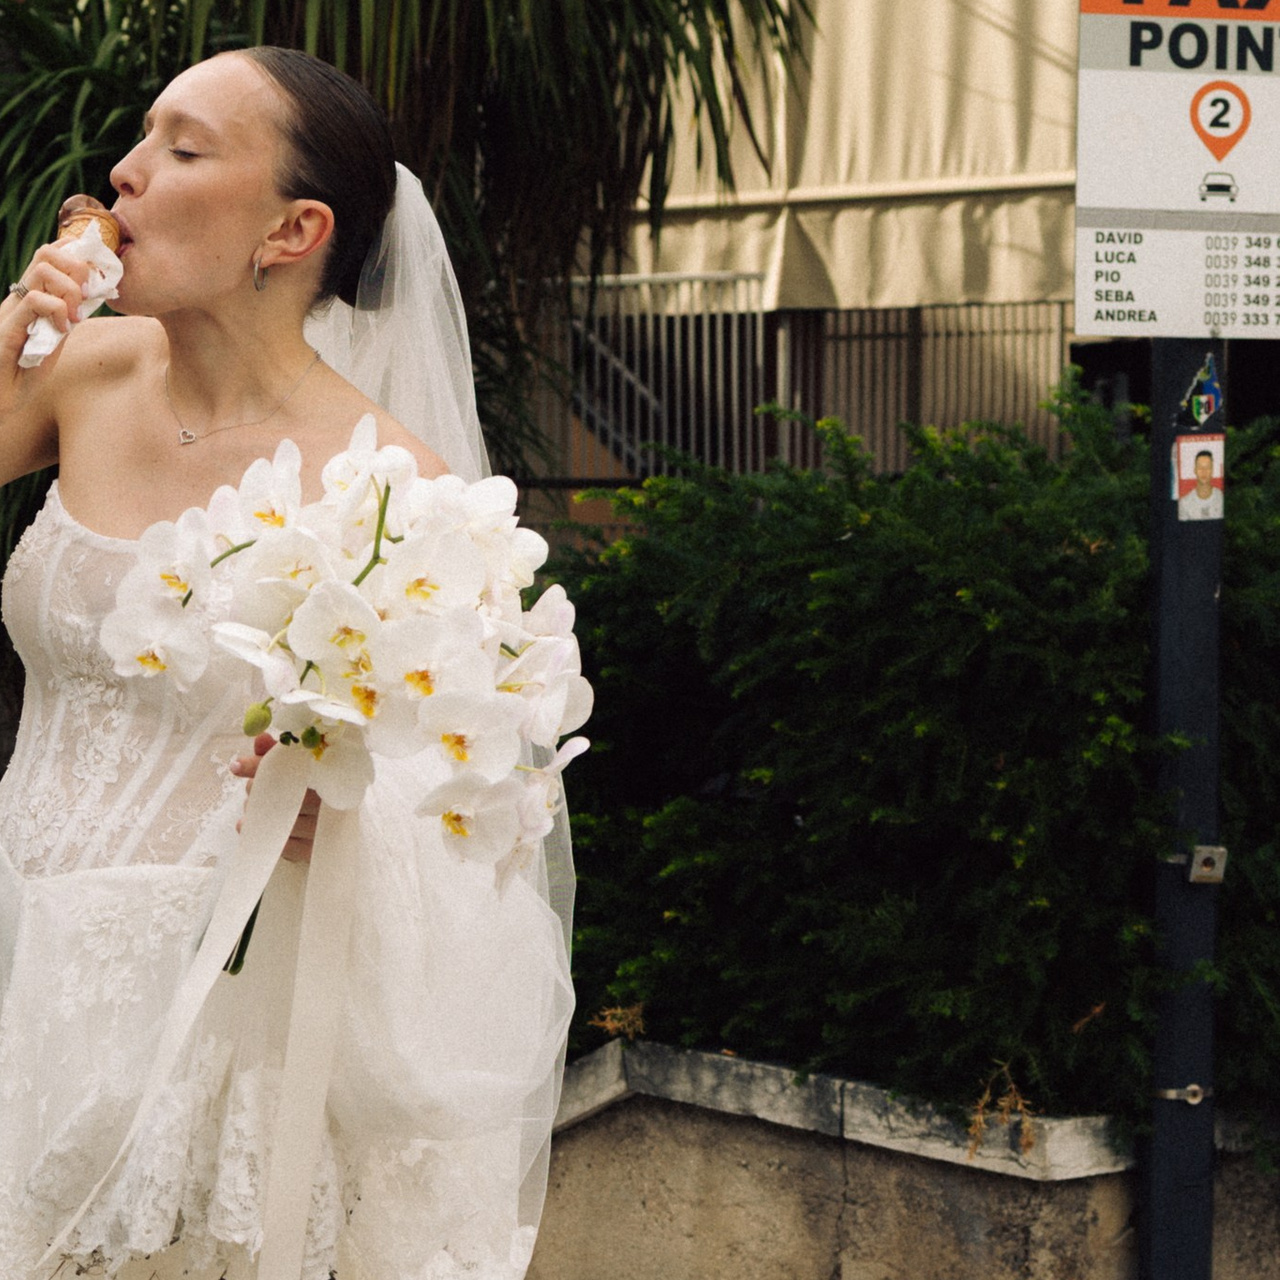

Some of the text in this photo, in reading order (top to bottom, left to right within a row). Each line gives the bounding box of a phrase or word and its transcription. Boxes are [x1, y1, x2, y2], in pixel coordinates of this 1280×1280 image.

[1129, 21, 1280, 72] POIN
[1209, 97, 1231, 129] 2
[1095, 231, 1144, 245] DAVID
[1205, 235, 1239, 251] 0039
[1245, 236, 1271, 250] 349
[1095, 251, 1137, 264] LUCA
[1205, 255, 1239, 269] 0039
[1244, 255, 1271, 269] 348
[1094, 270, 1121, 283] PIO
[1204, 274, 1238, 288] 0039
[1243, 274, 1270, 287] 349
[1094, 289, 1135, 302] SEBA
[1204, 293, 1238, 307] 0039
[1242, 294, 1270, 307] 349
[1094, 309, 1157, 322] ANDREA
[1204, 311, 1237, 326] 0039
[1242, 313, 1269, 326] 333
